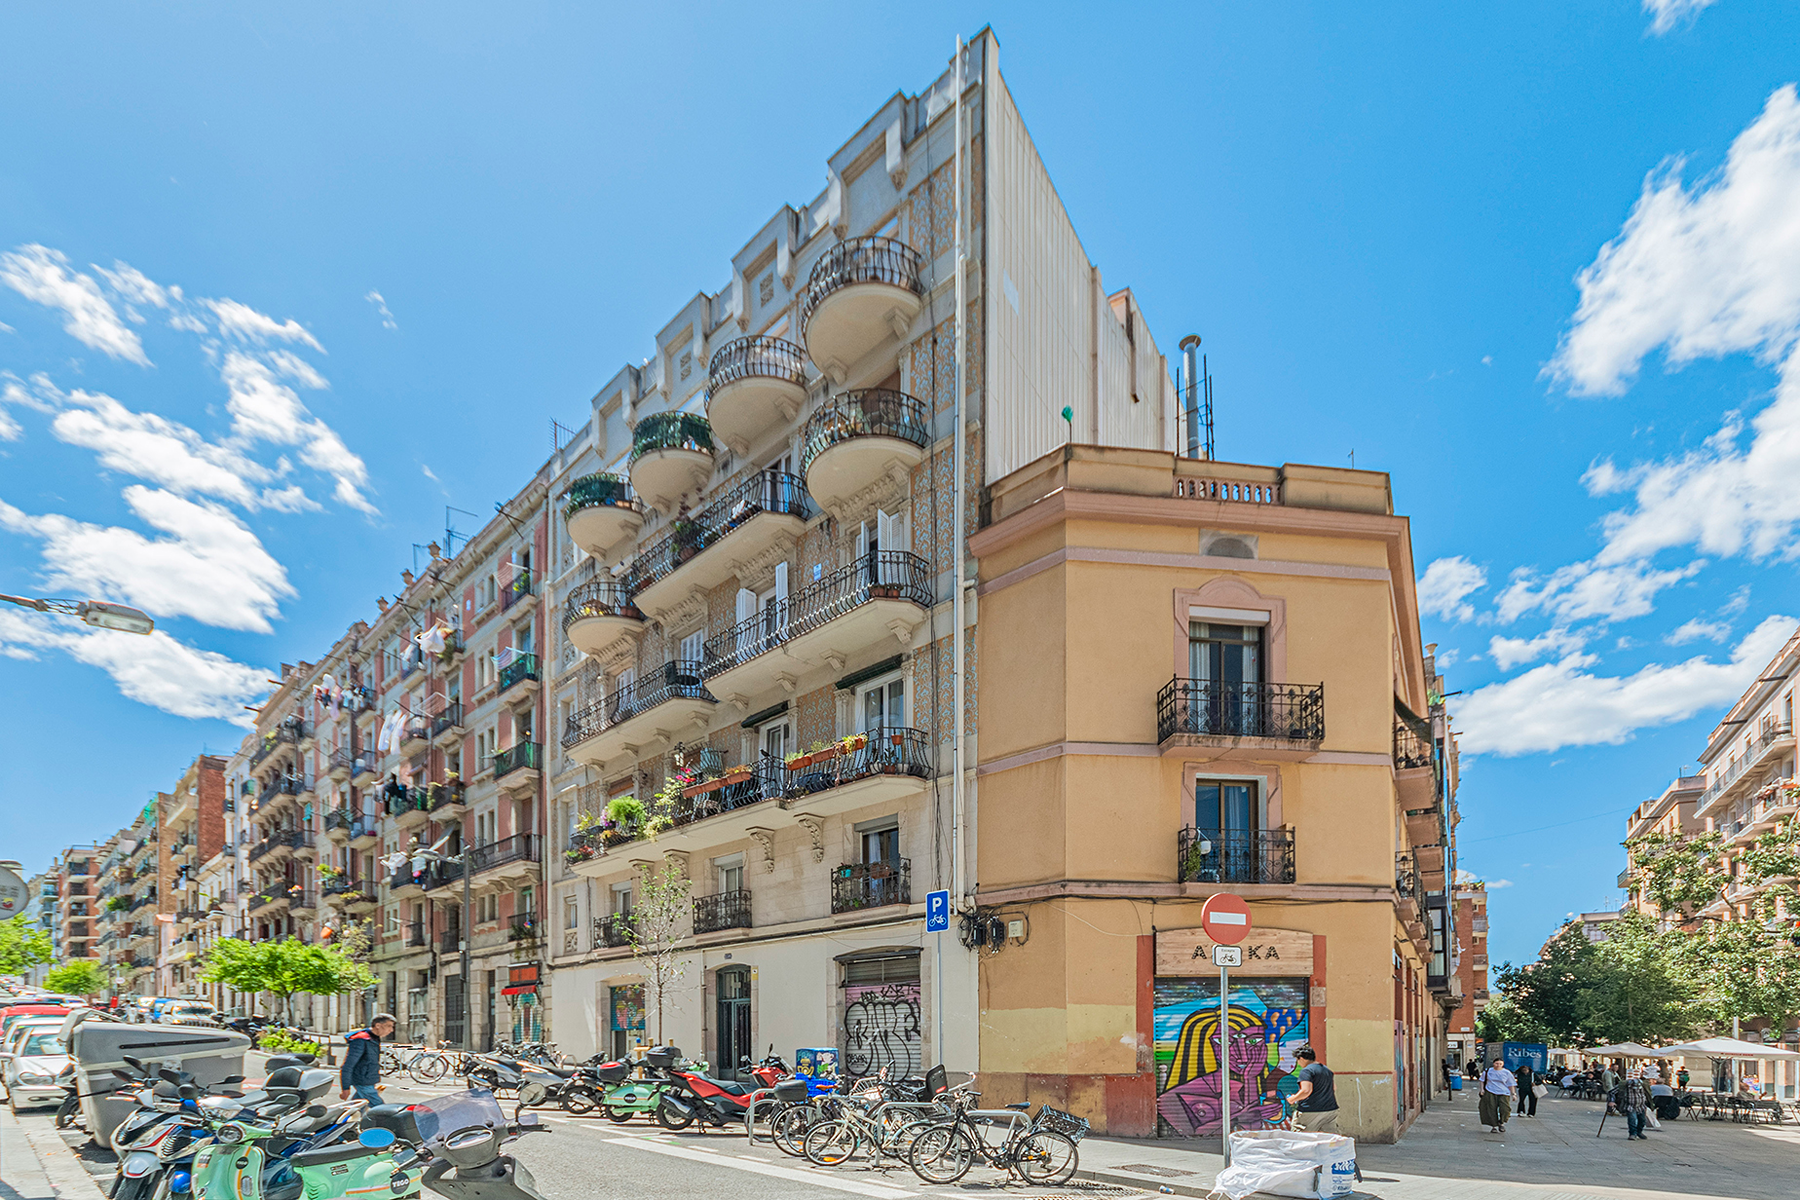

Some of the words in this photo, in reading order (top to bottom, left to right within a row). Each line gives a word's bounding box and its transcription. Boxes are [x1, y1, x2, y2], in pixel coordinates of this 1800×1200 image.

[933, 897, 943, 912] P
[1191, 945, 1280, 960] AKA
[1508, 1047, 1542, 1059] Ribes
